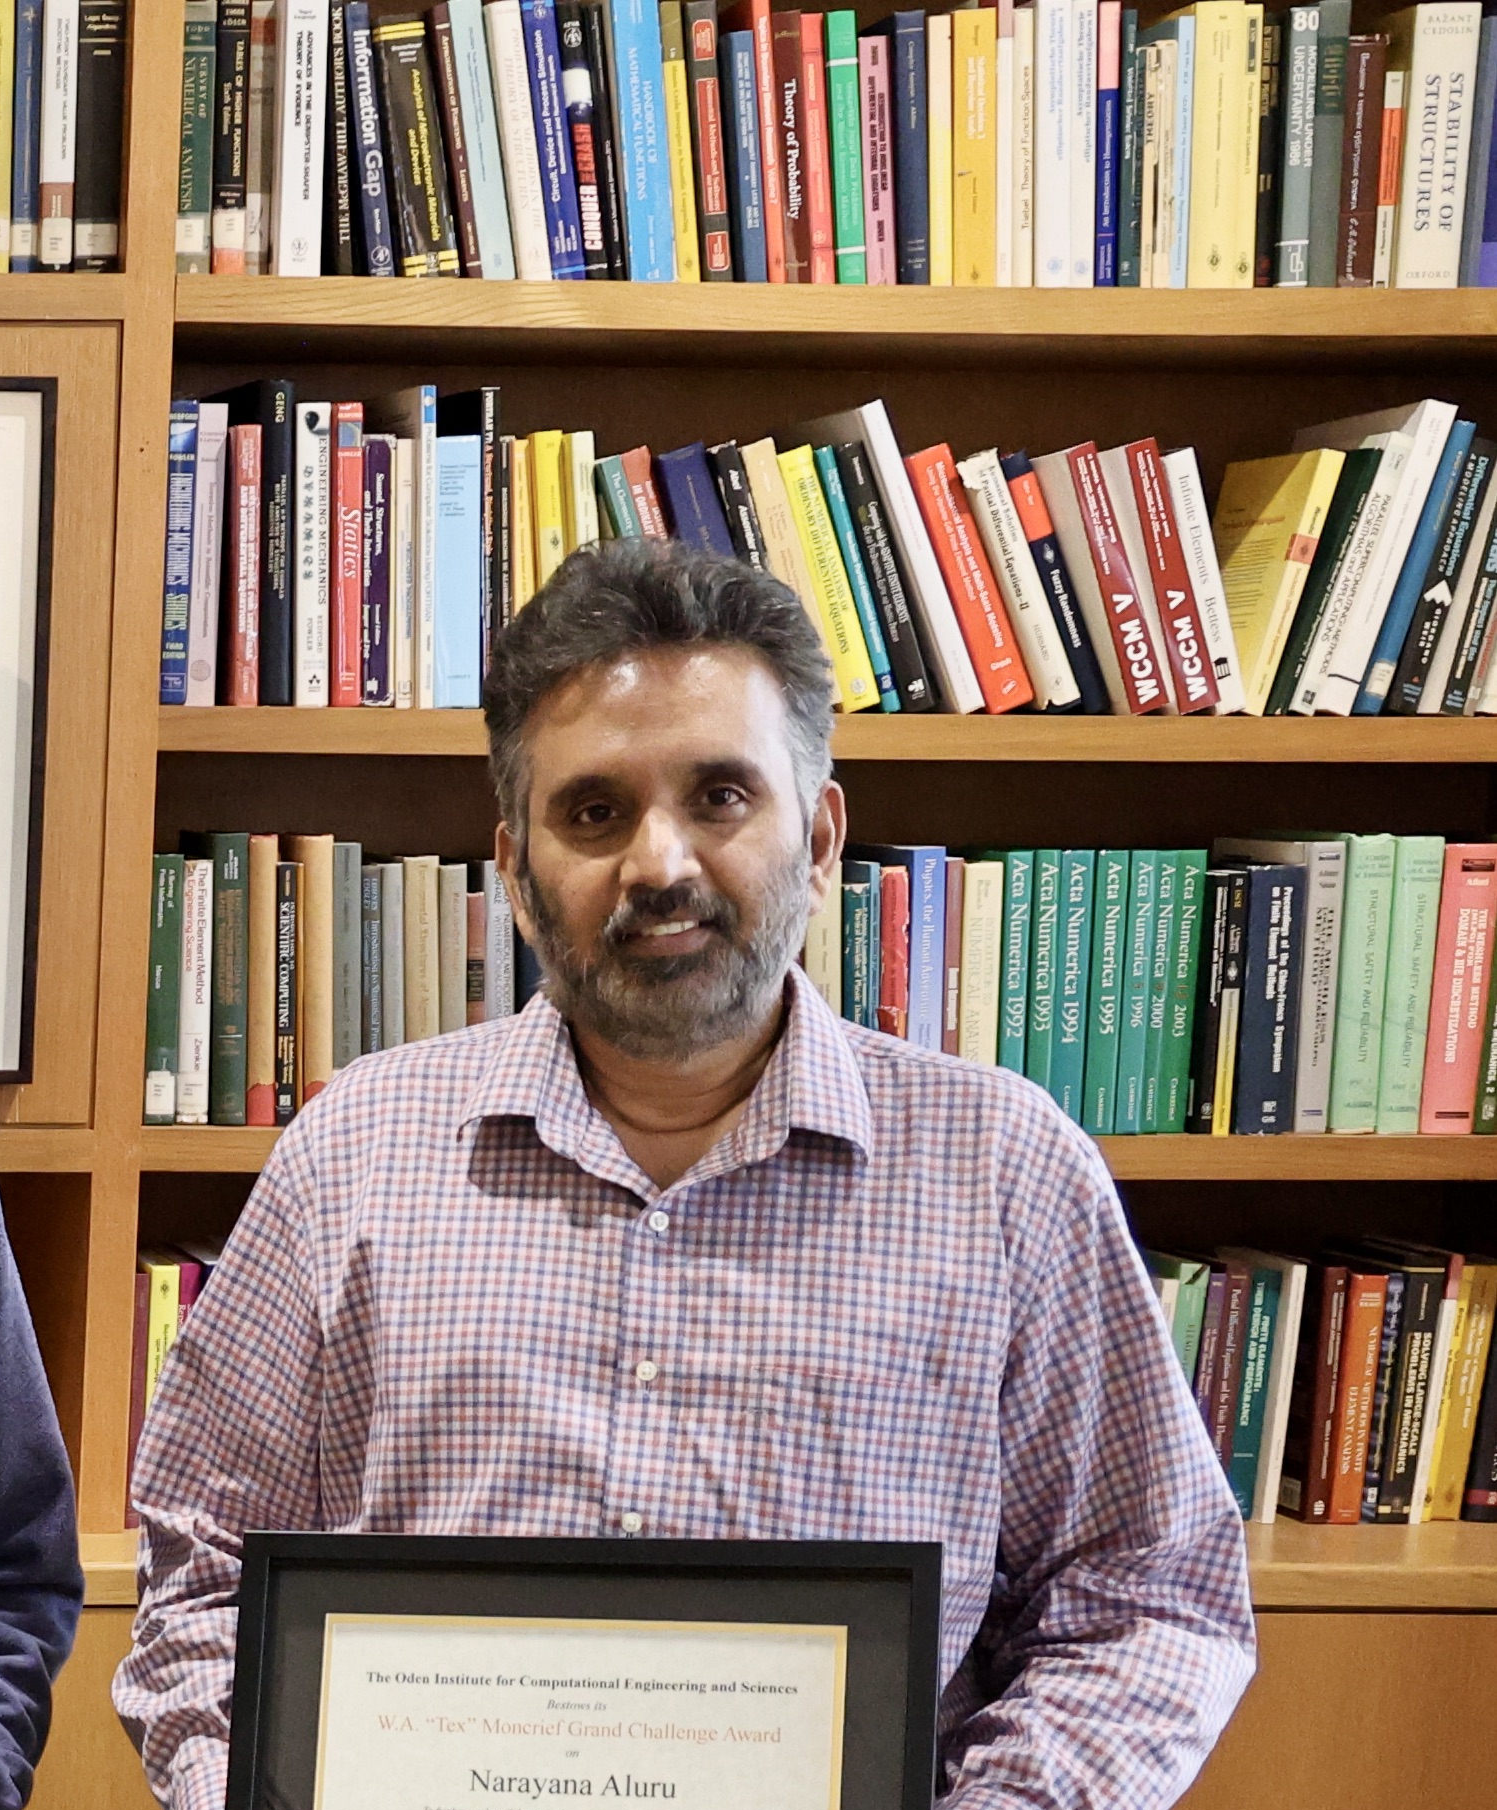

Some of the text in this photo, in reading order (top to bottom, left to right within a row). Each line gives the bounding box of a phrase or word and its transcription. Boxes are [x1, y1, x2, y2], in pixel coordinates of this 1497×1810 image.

[181, 57, 196, 211] NUMERICAL ANALYSIS
[353, 30, 383, 196] Information Gap
[783, 79, 802, 219] Theory of Probability
[1415, 74, 1440, 231] STRUCTURES
[1439, 72, 1464, 231] STABILITY OF
[318, 437, 327, 605] ENGINEERING MECHANICS
[340, 506, 361, 578] Statics
[1178, 474, 1222, 643] Infinite Elements Bettess
[1050, 569, 1082, 648] Fuzzy Randomness
[1112, 593, 1161, 704] WCCM V
[1167, 590, 1209, 701] WCCM V
[195, 868, 207, 1004] The Finite Element Method
[278, 901, 290, 1027] SCIENTIFIC COMPUTING
[1007, 859, 1029, 1037] Acta Numerica 1992
[1061, 862, 1087, 1043] Acta Numerica 1994
[1099, 861, 1122, 1034] Acta Numerica 1995
[366, 1671, 797, 1695] The Oden Institute for Computational Engineering and Sciences
[378, 1715, 419, 1732] W.A.
[481, 1718, 565, 1737] Moncrief
[567, 1720, 622, 1739] Grand
[627, 1722, 717, 1745] Challenge
[722, 1725, 781, 1744] Award
[546, 1699, 606, 1711] Bestows its
[469, 1769, 676, 1799] Narayana Aluru
[565, 1749, 579, 1758] on
